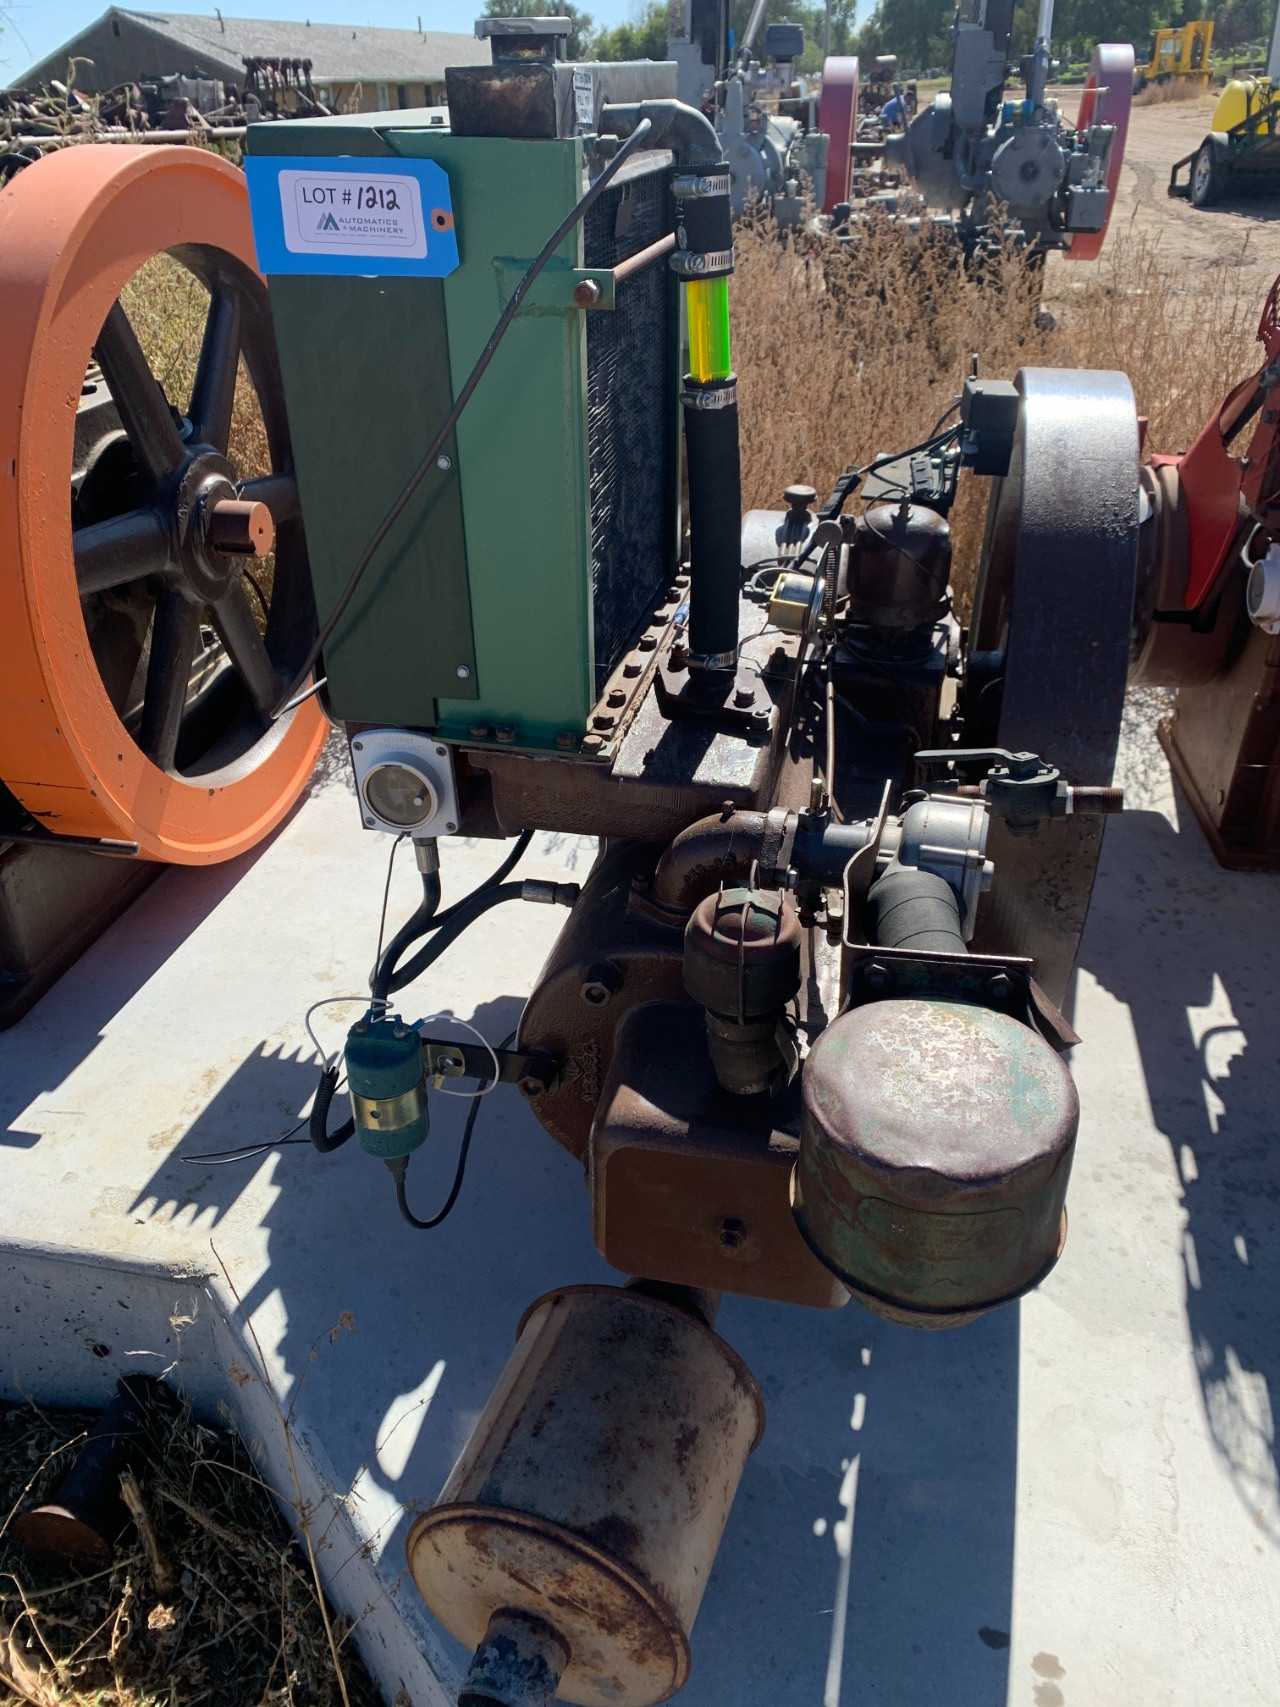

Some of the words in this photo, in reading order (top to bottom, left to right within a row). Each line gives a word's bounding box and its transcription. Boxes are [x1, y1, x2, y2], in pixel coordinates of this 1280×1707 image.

[302, 187, 336, 204] LOT
[339, 217, 398, 226] AUTOMATICS
[350, 225, 404, 234] MACHINERY
